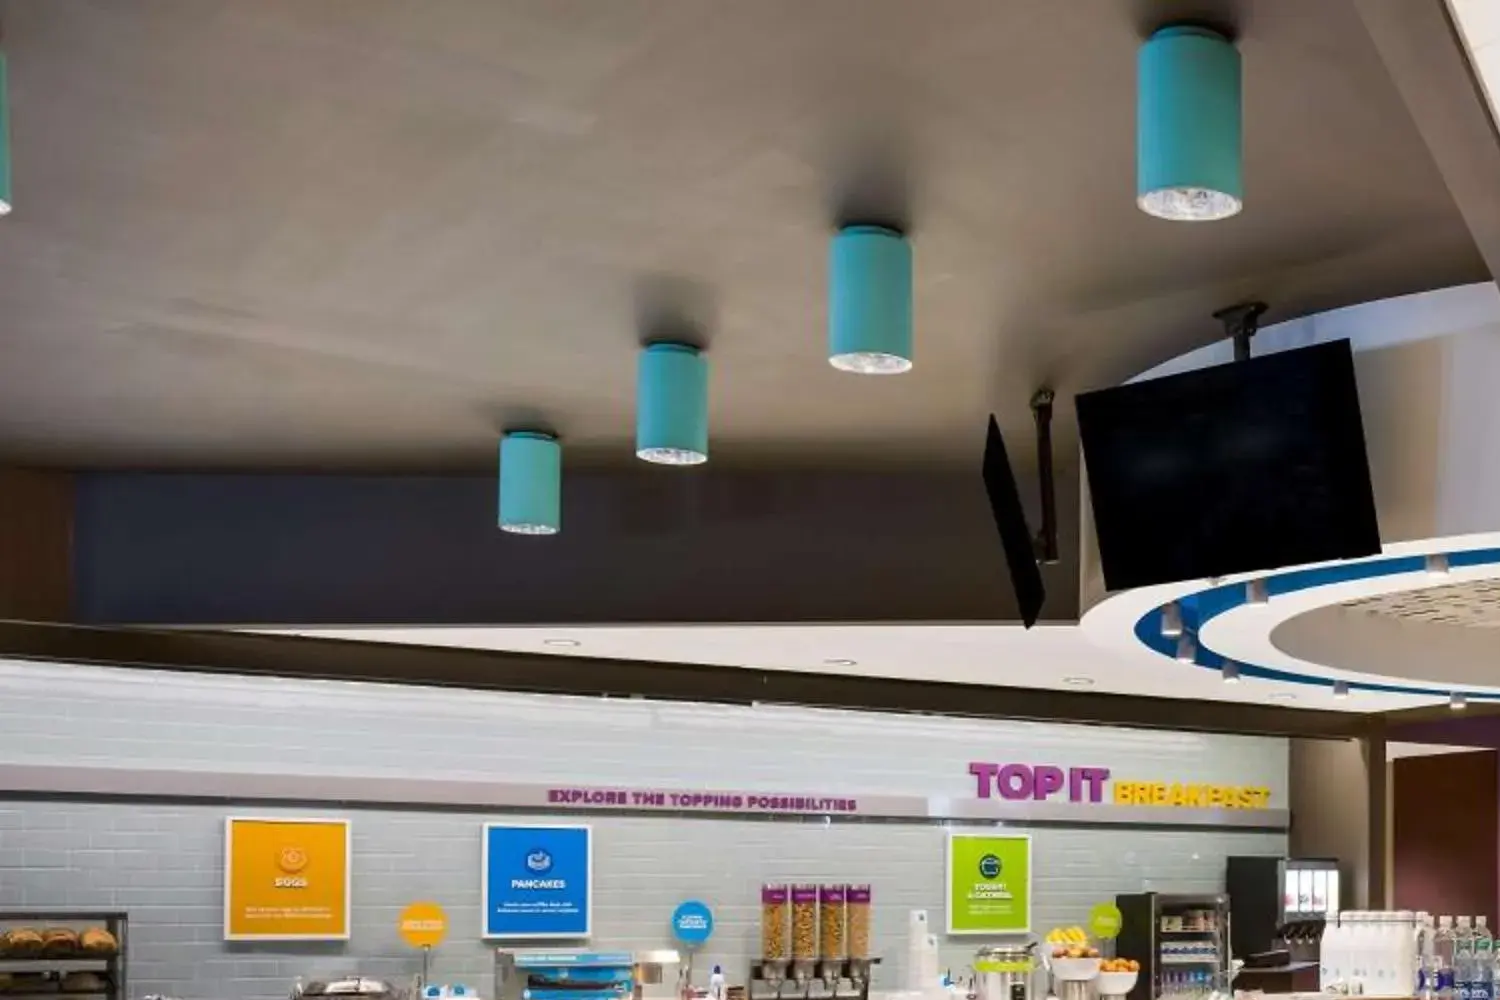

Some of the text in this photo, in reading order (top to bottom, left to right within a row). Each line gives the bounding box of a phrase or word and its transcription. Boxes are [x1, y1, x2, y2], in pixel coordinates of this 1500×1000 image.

[970, 762, 1110, 802] TOP IT
[547, 789, 857, 811] EXPLORE THE TOPPING POSSIBILITIES
[1114, 781, 1271, 808] BREAKFAST
[511, 879, 567, 889] PANCAKES
